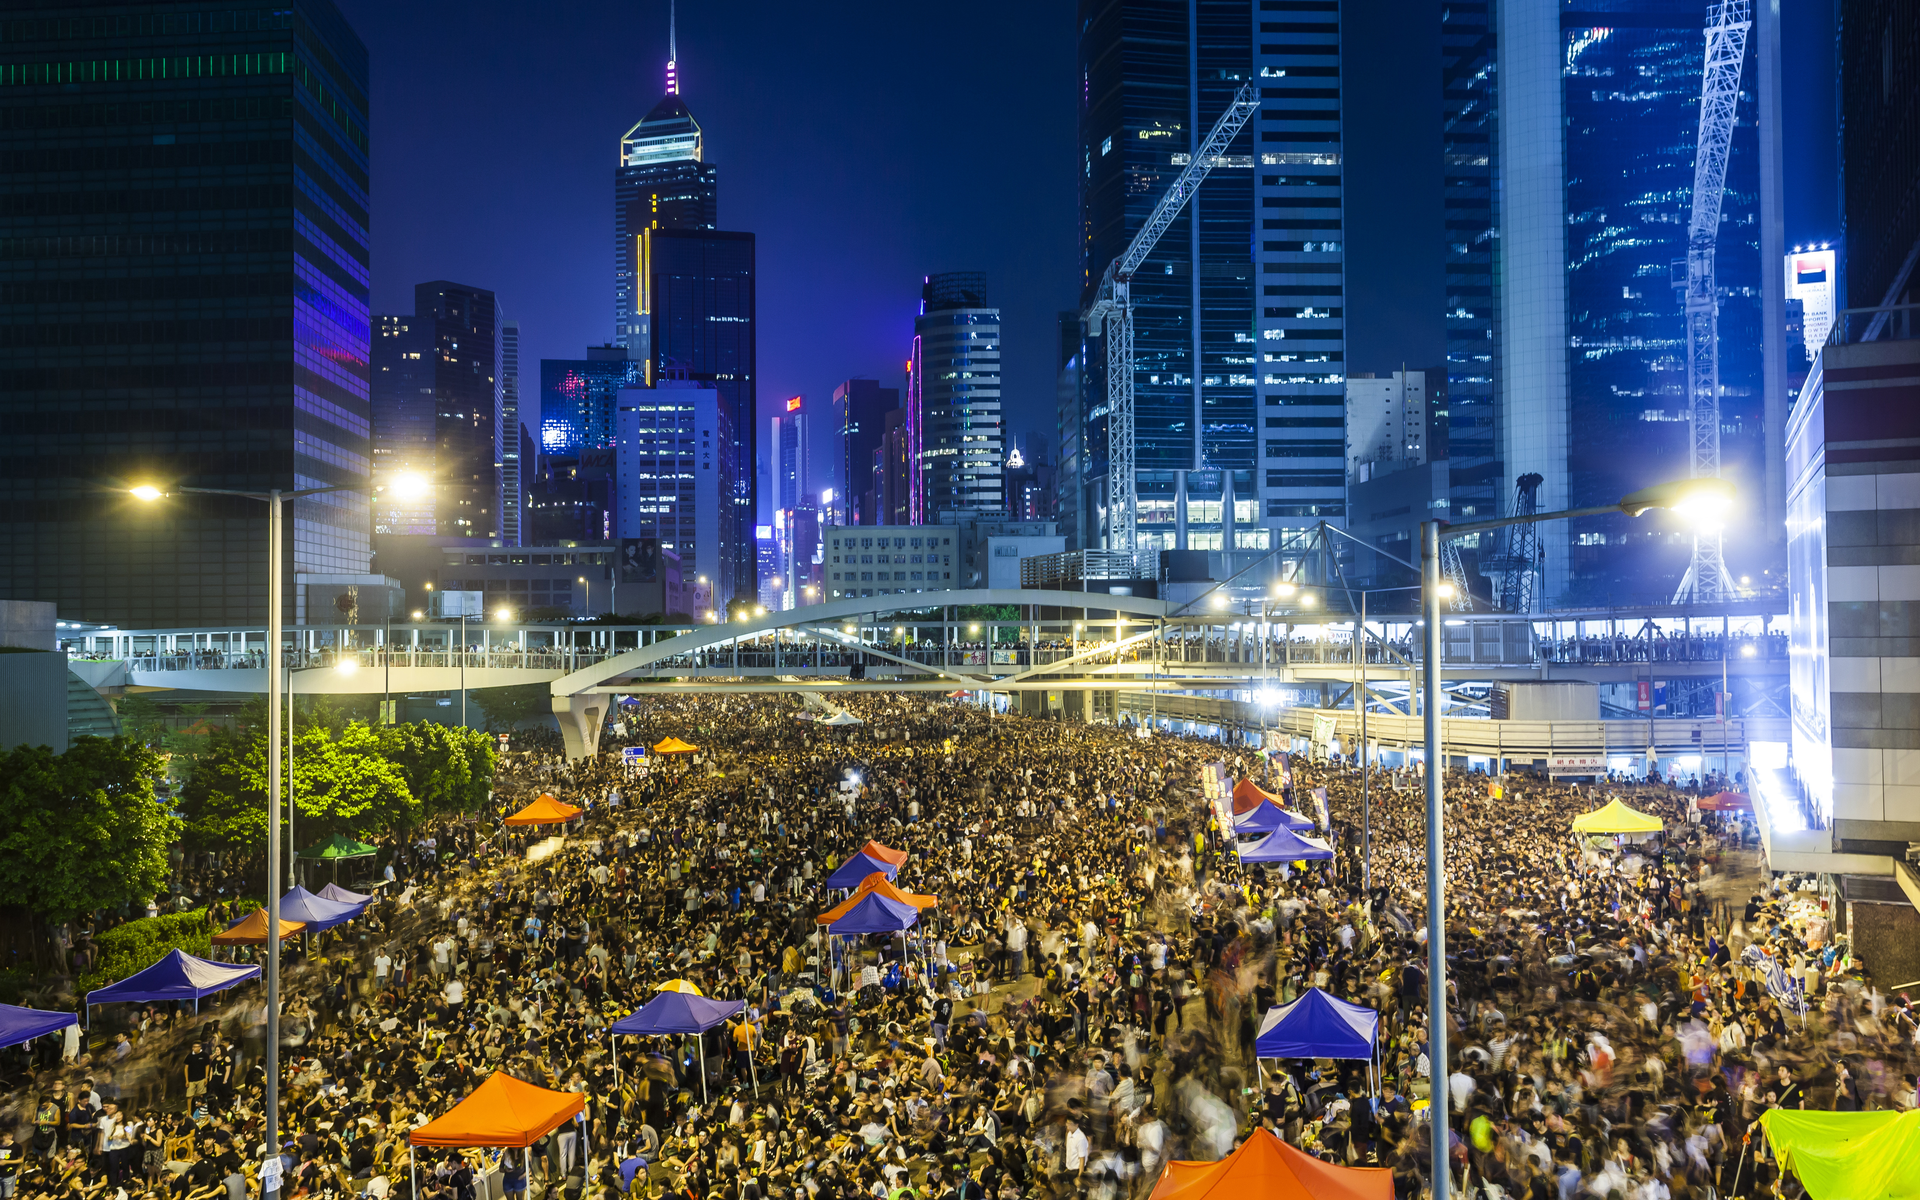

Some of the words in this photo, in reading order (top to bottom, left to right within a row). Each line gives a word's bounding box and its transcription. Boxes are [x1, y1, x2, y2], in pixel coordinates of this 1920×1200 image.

[581, 451, 614, 471] YMCA
[971, 651, 986, 664] 香港
[994, 651, 1010, 663] 加油
